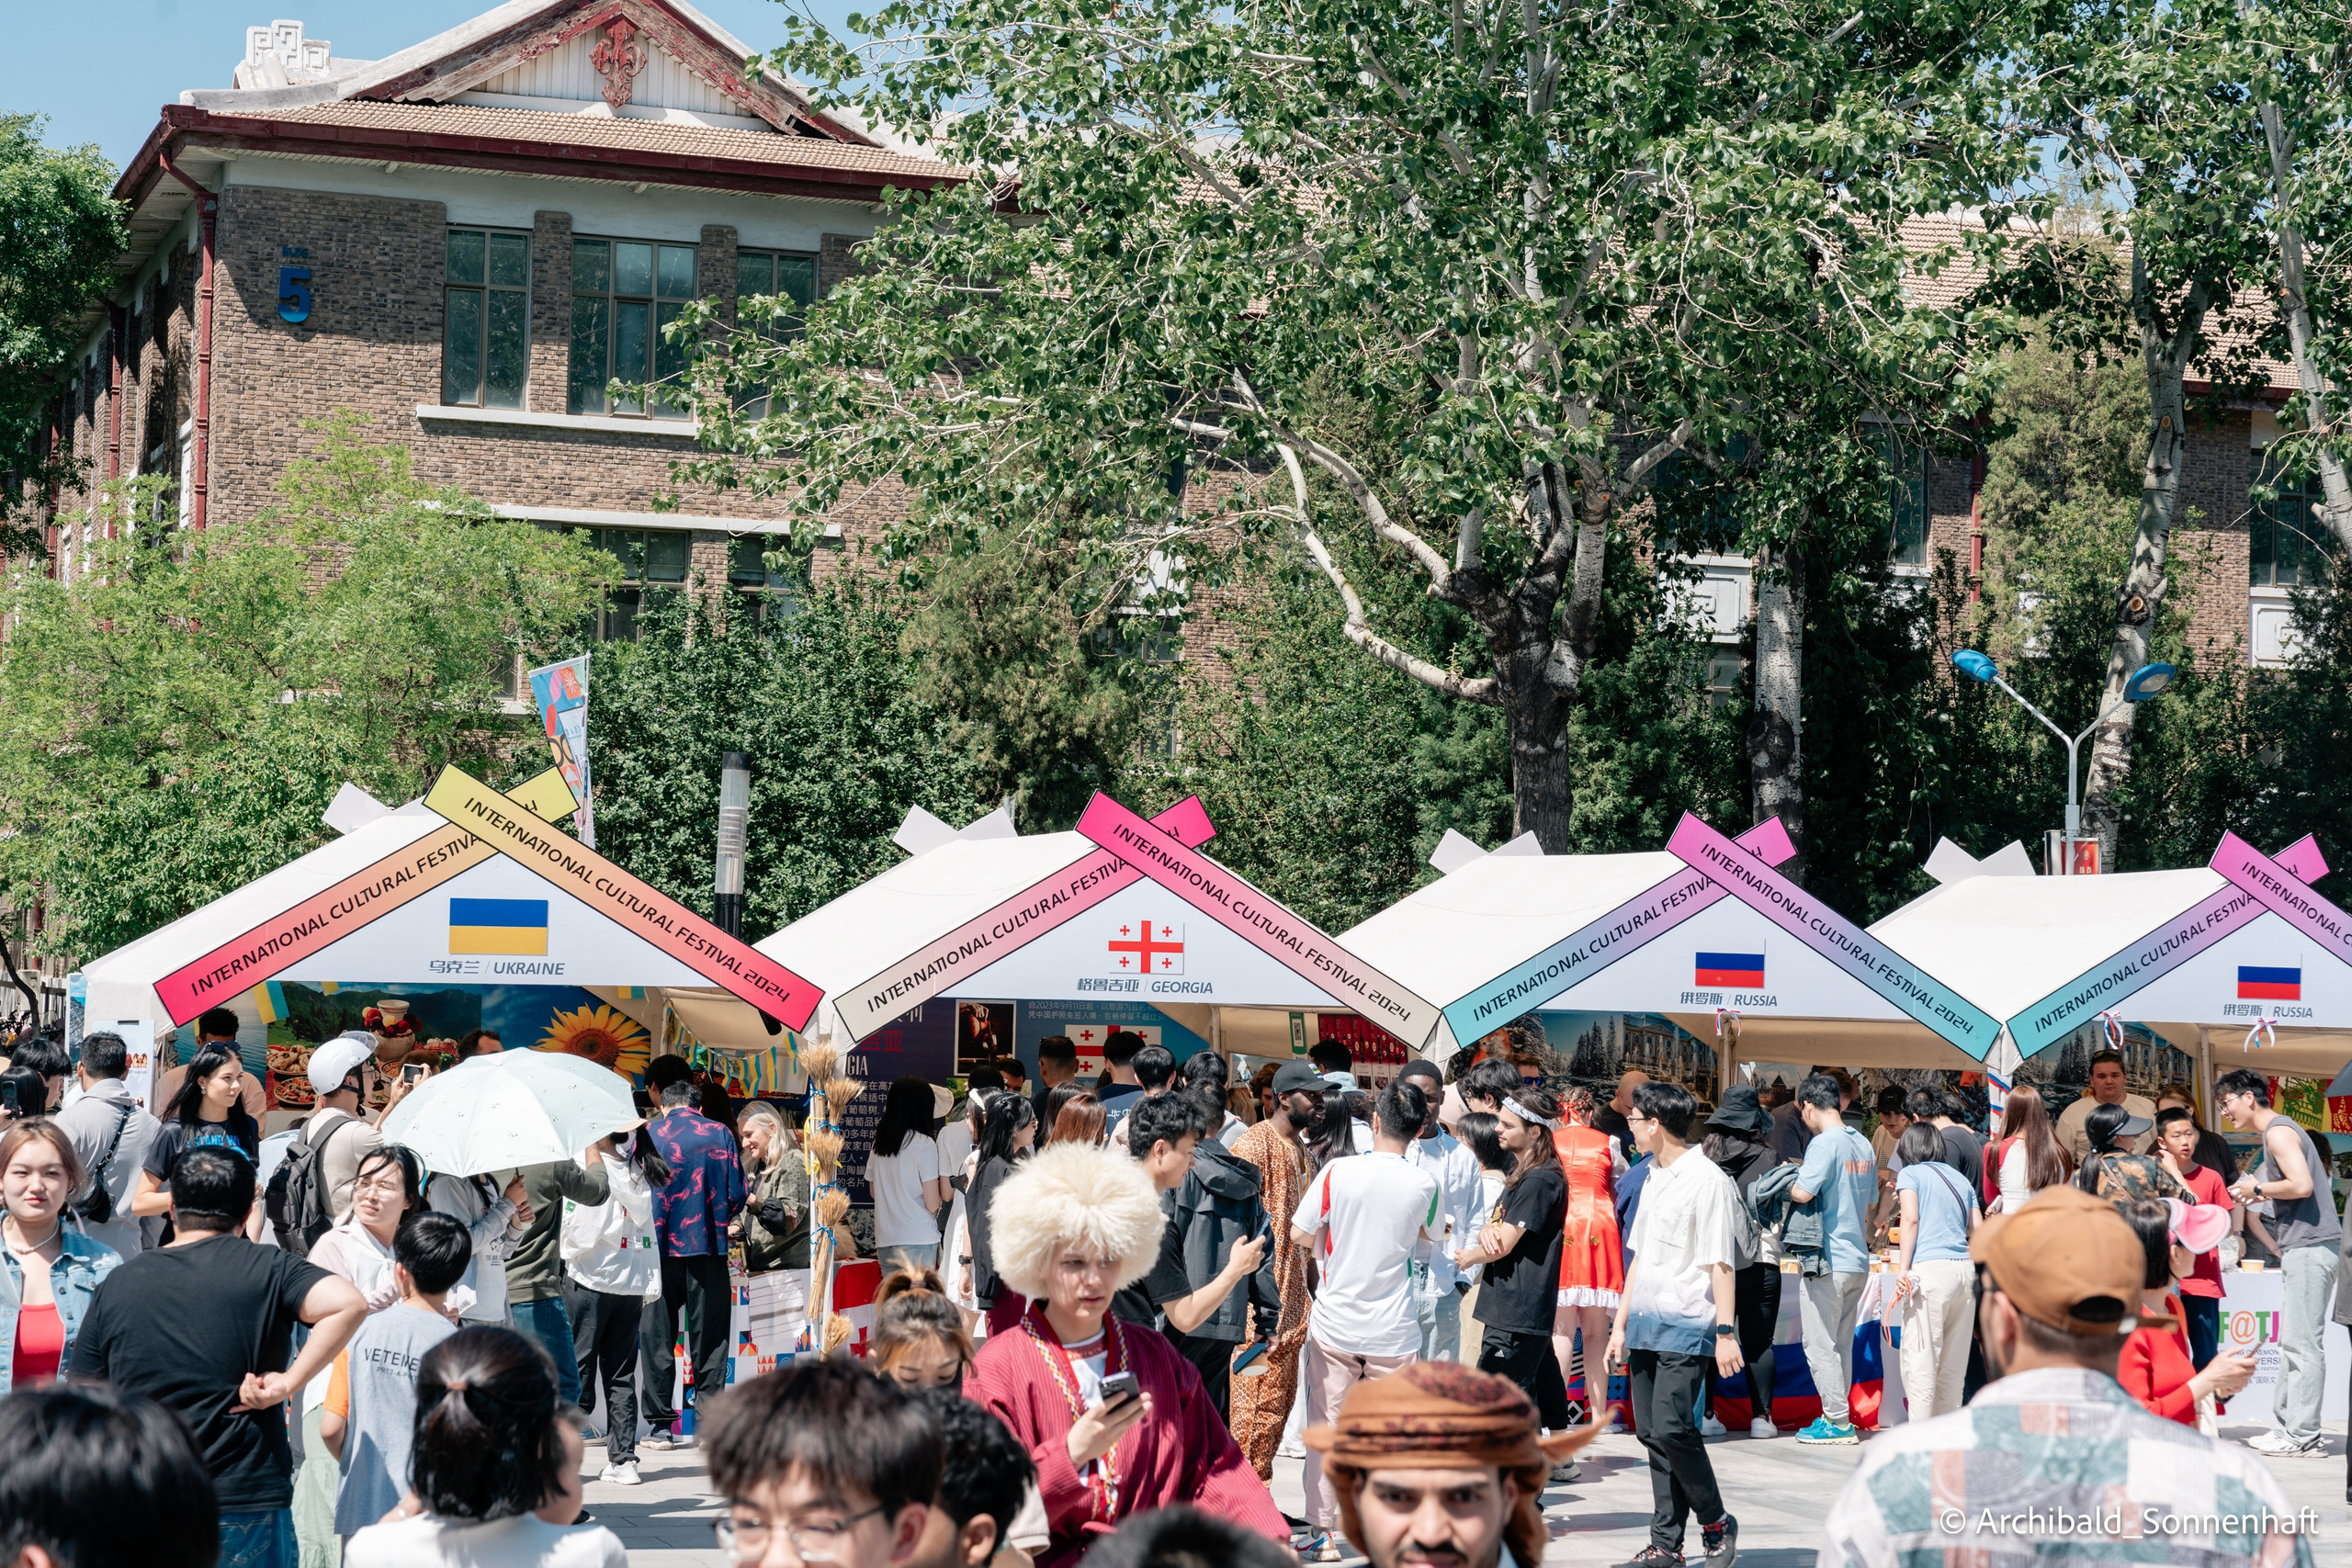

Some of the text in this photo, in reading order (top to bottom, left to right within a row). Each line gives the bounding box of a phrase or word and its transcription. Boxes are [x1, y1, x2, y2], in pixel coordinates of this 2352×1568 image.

[277, 265, 311, 323] 5
[191, 833, 481, 997] INTERNATIONAL CULTURAL FESTIVA
[464, 797, 790, 1002] INTERNATIONAL CULTURAL FESTIVAL 2024
[2242, 862, 2343, 939] INTERNATIONAL
[867, 858, 1129, 1012] INTERNATIONAL CULTURAL FESTIVA
[1114, 824, 1411, 1021] INTERNATIONAL CULTURAL FESTIVAL 2024
[1701, 843, 1973, 1034] INTERNATIONAL CULTURAL FESTIVAL 2024
[1474, 876, 1714, 1021] INTERNATIONAL CULTURAL FESTIVA
[2035, 893, 2256, 1032] INTERNATIONAL CULTURAL FESTIVA
[429, 960, 565, 976] 乌克兰 UKRAINE
[1077, 978, 1213, 994] 格鲁吉亚 GEORGIA
[1680, 992, 1778, 1007] 俄罗斯 RUSSIA
[2223, 1004, 2313, 1018] 俄罗斯 RUSSIA
[862, 1030, 904, 1052] 吉亚
[847, 1055, 868, 1076] GIA
[840, 1129, 876, 1139] 00多年的
[843, 1141, 872, 1151] 家家自
[2218, 1311, 2279, 1345] F@TJ
[365, 1348, 421, 1371] VETEME
